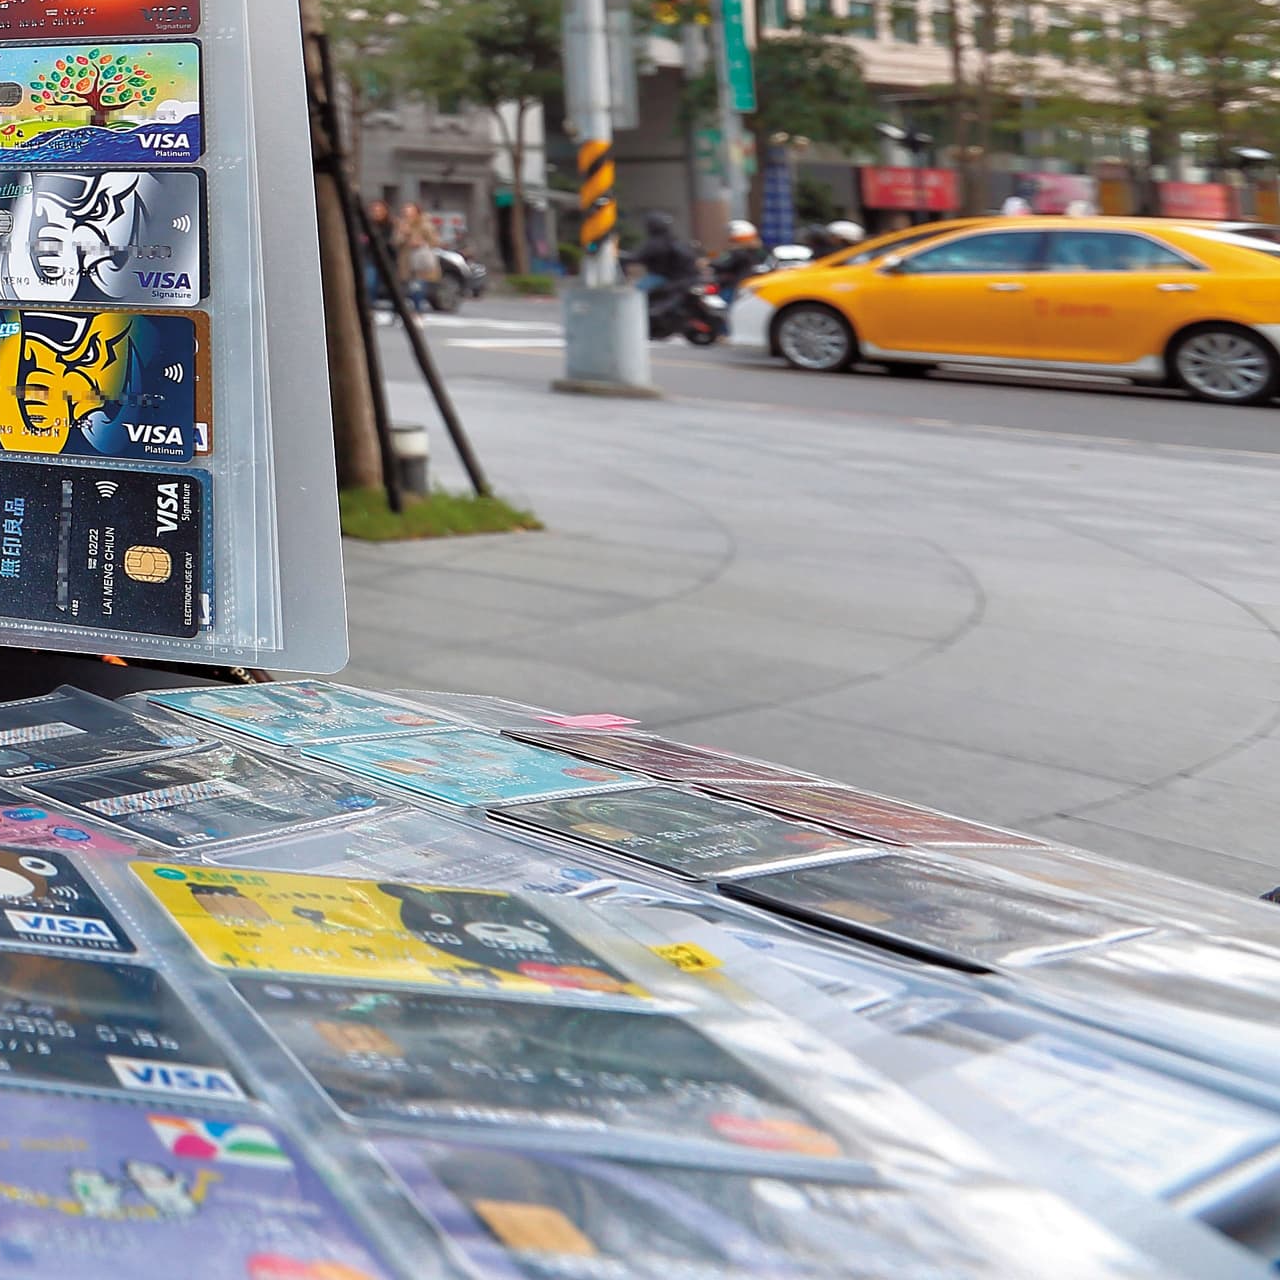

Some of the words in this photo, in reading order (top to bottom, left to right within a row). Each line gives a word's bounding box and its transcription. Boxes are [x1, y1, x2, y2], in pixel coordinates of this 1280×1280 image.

[142, 6, 192, 21] VISA
[137, 133, 190, 149] VISA
[134, 272, 192, 290] VISA
[151, 290, 192, 299] Signature
[122, 423, 184, 446] VISA
[144, 445, 184, 456] Platinum
[156, 483, 179, 537] VISA
[181, 483, 191, 522] Signature
[0, 497, 26, 579] 無印良品
[88, 528, 99, 556] 02/22
[104, 526, 115, 561] CHIUN
[185, 551, 193, 569] ONLY
[103, 563, 114, 596] MENG
[184, 569, 192, 584] USE
[102, 599, 113, 615] LAI
[184, 584, 192, 626] ELECTRONIC
[19, 914, 111, 937] VISA
[18, 932, 122, 951] SIGNATURE
[124, 1063, 234, 1095] VISA
